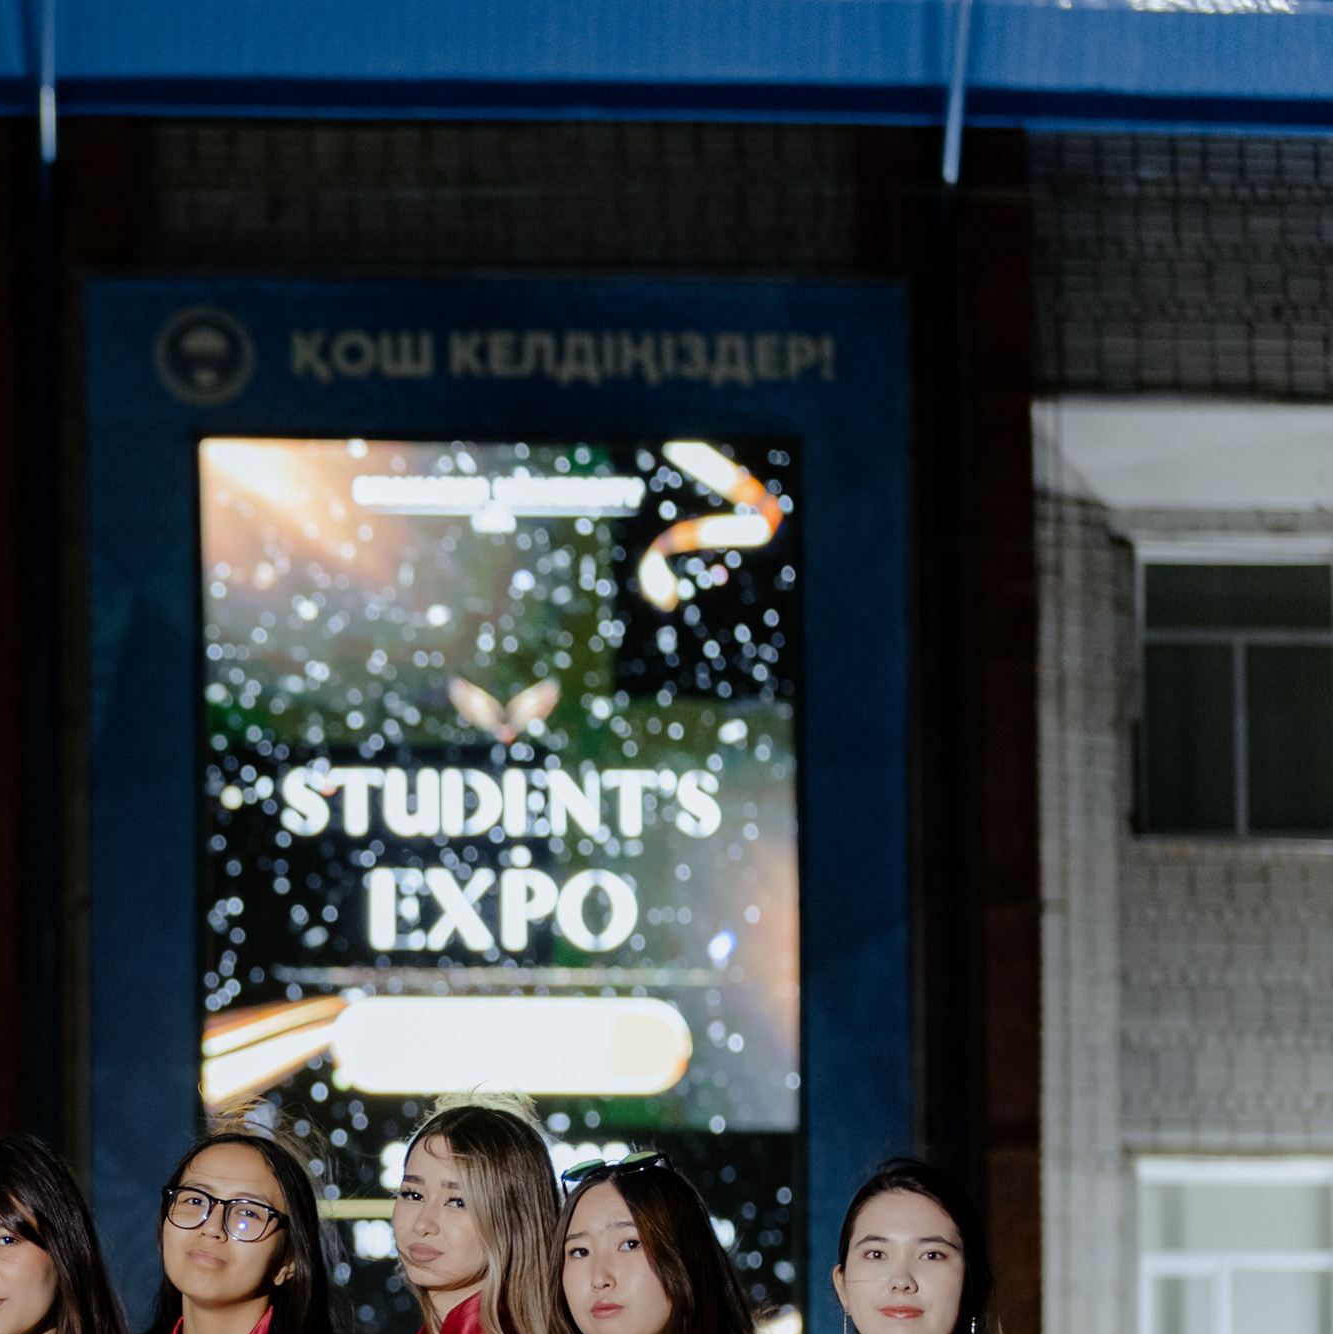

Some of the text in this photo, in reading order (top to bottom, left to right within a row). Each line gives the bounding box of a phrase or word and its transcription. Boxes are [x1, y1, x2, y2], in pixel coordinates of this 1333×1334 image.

[290, 328, 835, 388] ҚОШ КЕЛДІҢІЗДЕР!
[280, 766, 722, 838] STUDENT'S
[367, 866, 638, 952] EXPO
